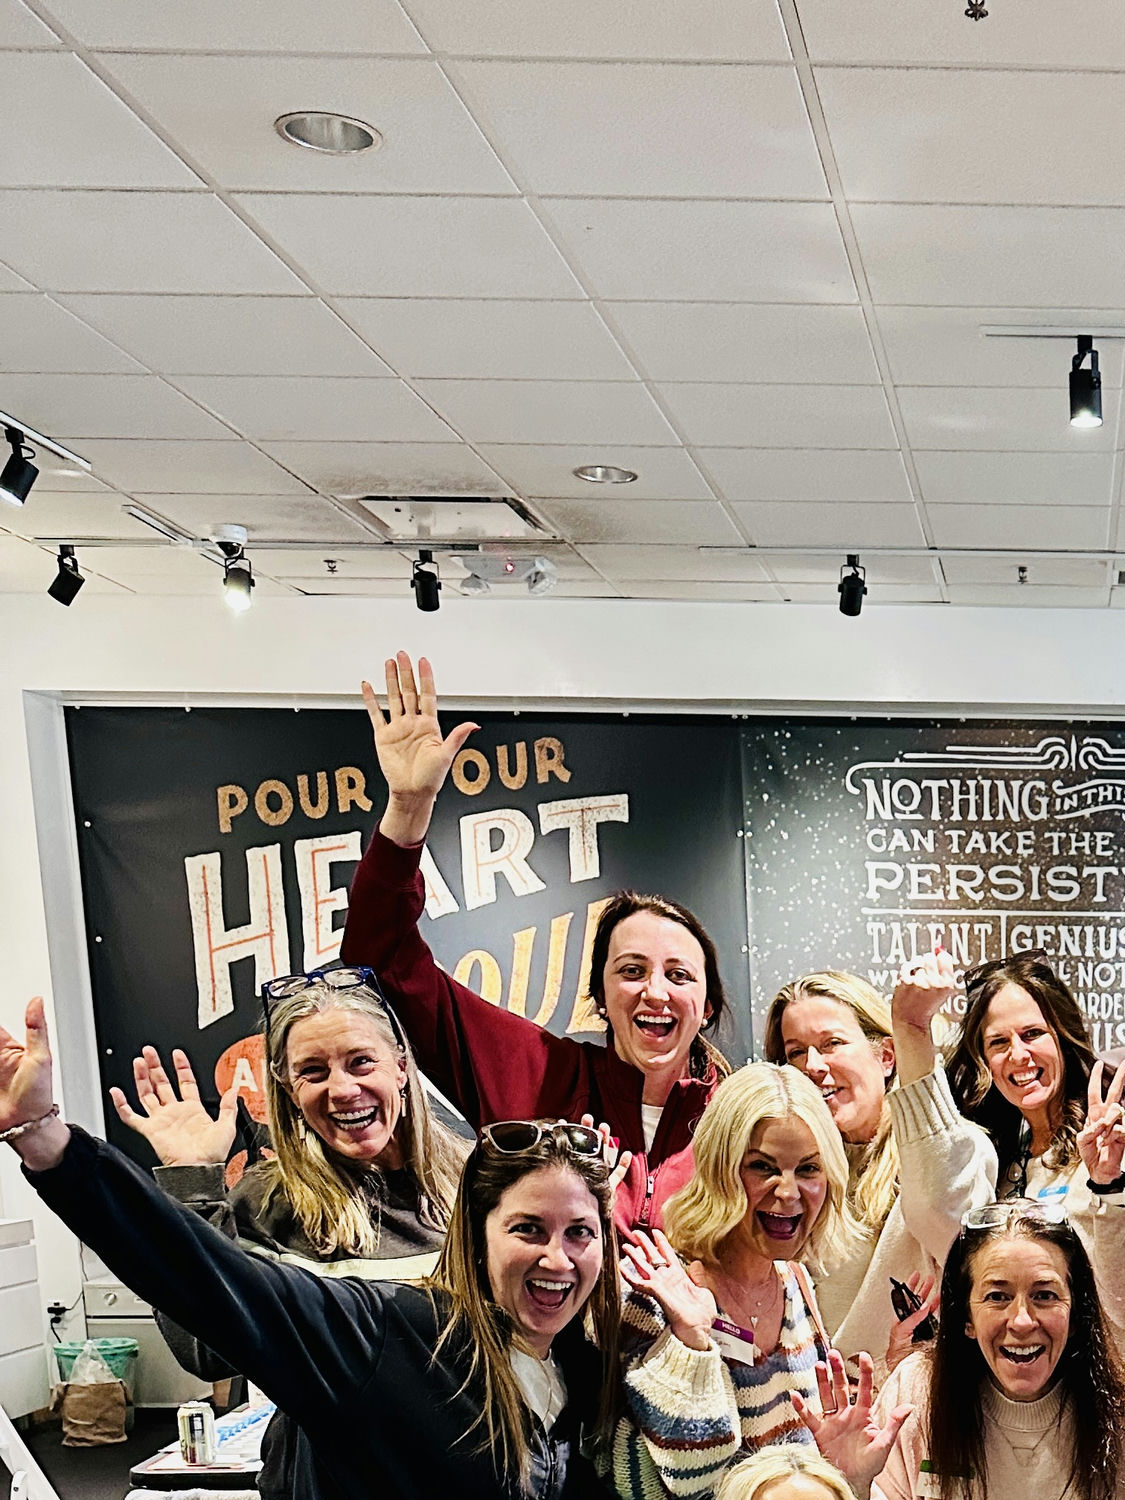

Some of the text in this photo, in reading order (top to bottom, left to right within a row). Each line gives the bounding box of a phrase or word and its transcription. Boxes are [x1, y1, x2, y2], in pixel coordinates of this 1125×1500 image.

[216, 736, 572, 833] POUR OUR
[861, 778, 1048, 823] NOTHING
[1055, 795, 1080, 811] IN
[866, 828, 935, 853] CAN
[945, 829, 1035, 854] TAKE
[1044, 831, 1115, 857] THE
[721, 1321, 741, 1335] HELLO
